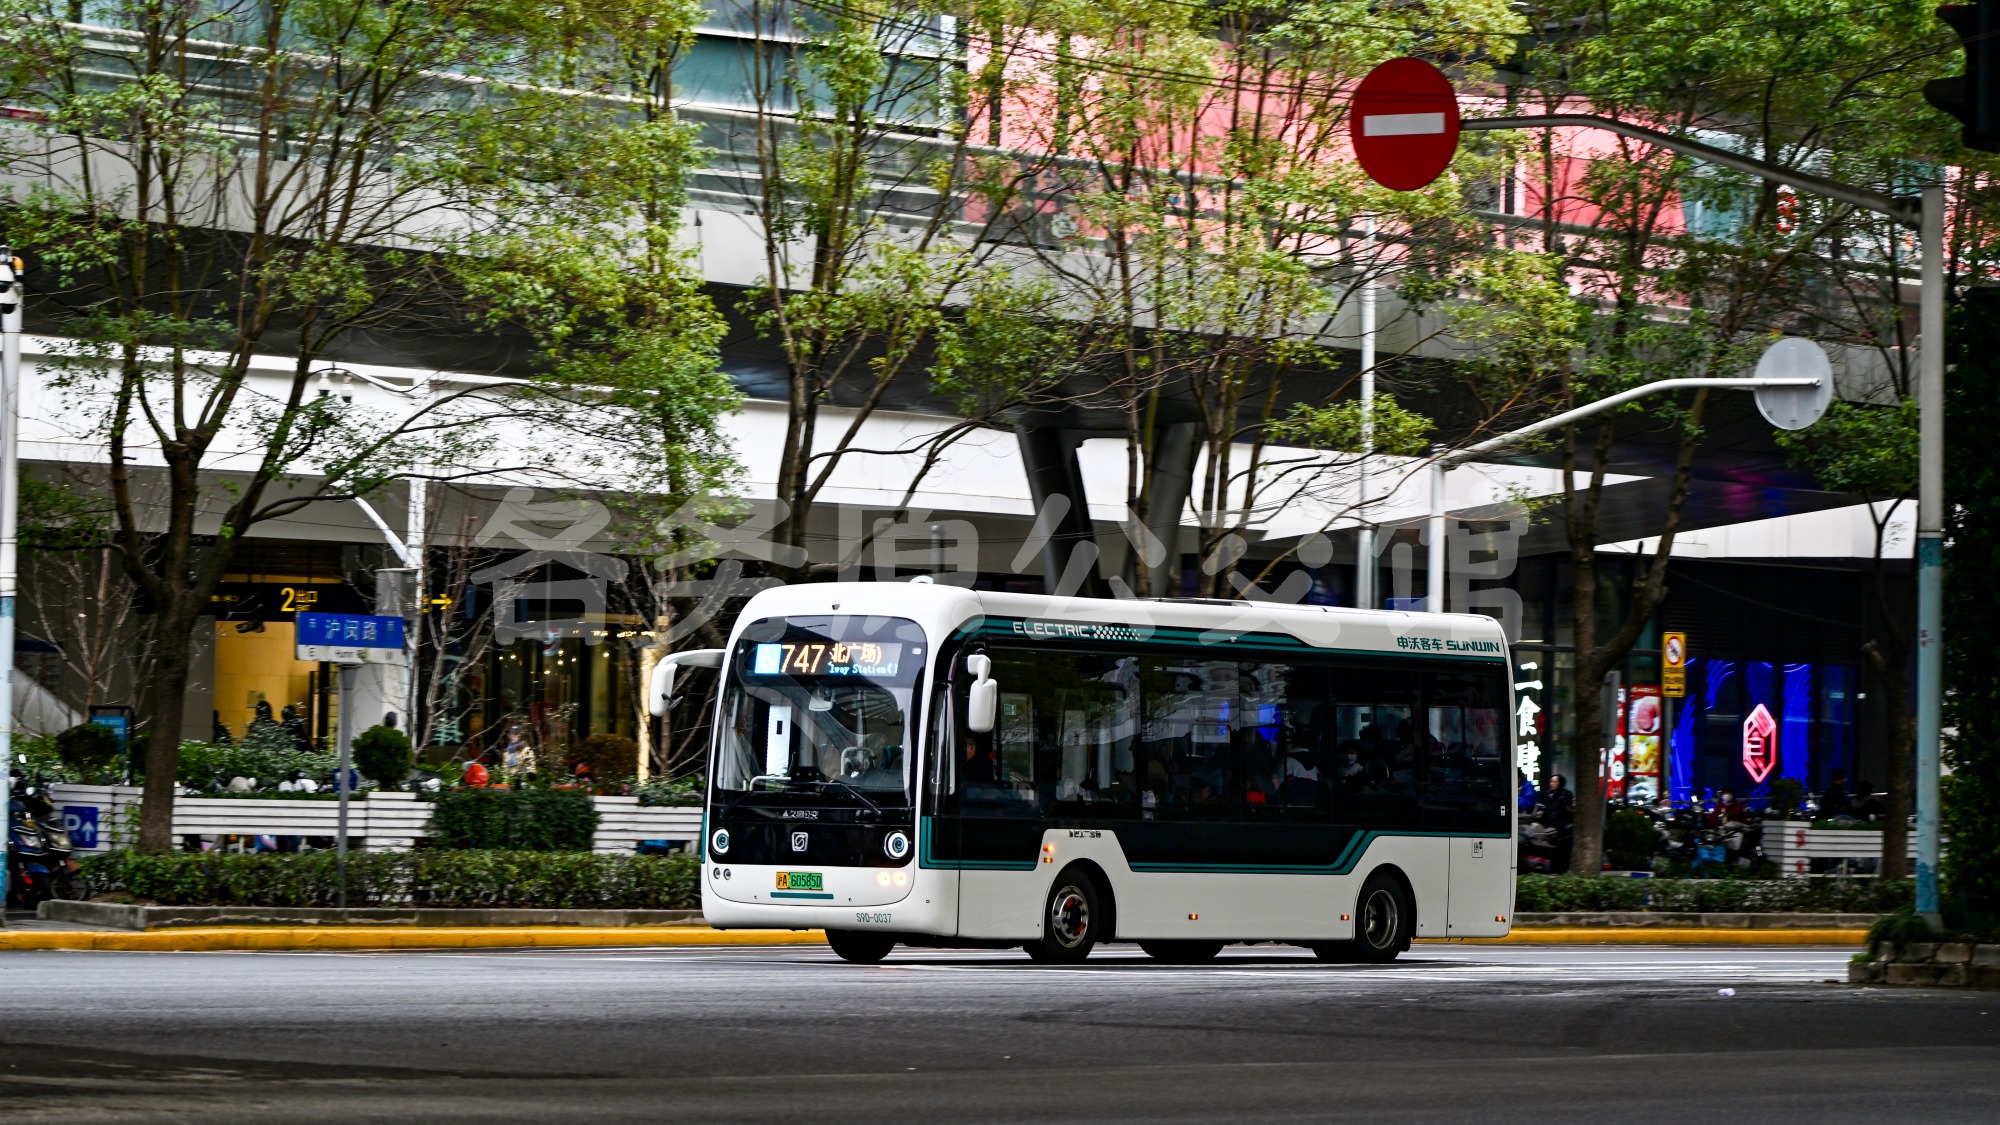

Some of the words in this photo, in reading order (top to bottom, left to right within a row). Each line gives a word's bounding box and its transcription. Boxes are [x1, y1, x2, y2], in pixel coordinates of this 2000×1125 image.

[281, 587, 295, 612] 2
[295, 590, 318, 604] 出口
[325, 618, 378, 641] 沪闵路
[1013, 621, 1090, 637] ELECTRIC
[1397, 636, 1443, 652] 申沃客车
[1446, 640, 1500, 653] SUNWIN
[780, 644, 825, 673] 747
[65, 813, 82, 831] P
[856, 913, 892, 924] S9D-0037
